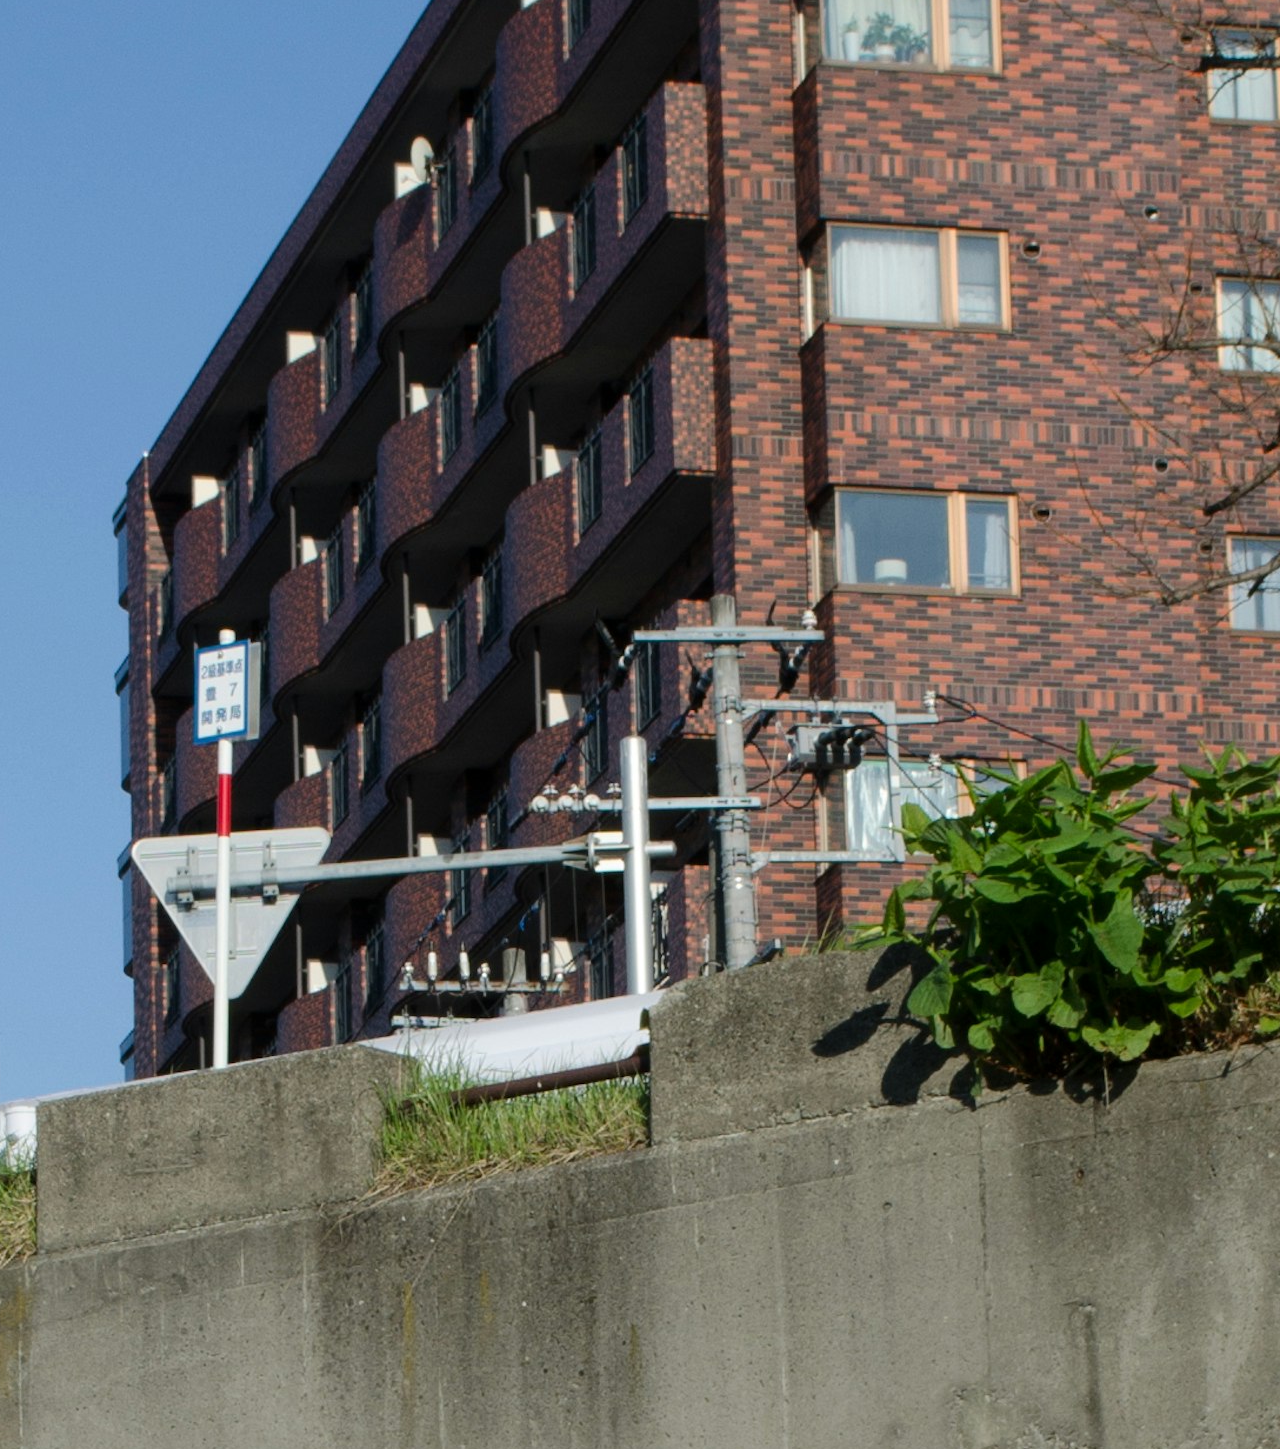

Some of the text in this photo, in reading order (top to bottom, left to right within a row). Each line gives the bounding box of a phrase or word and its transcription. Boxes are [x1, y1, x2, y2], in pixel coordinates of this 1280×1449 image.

[229, 682, 237, 697] 7
[201, 704, 241, 725] 開発局
